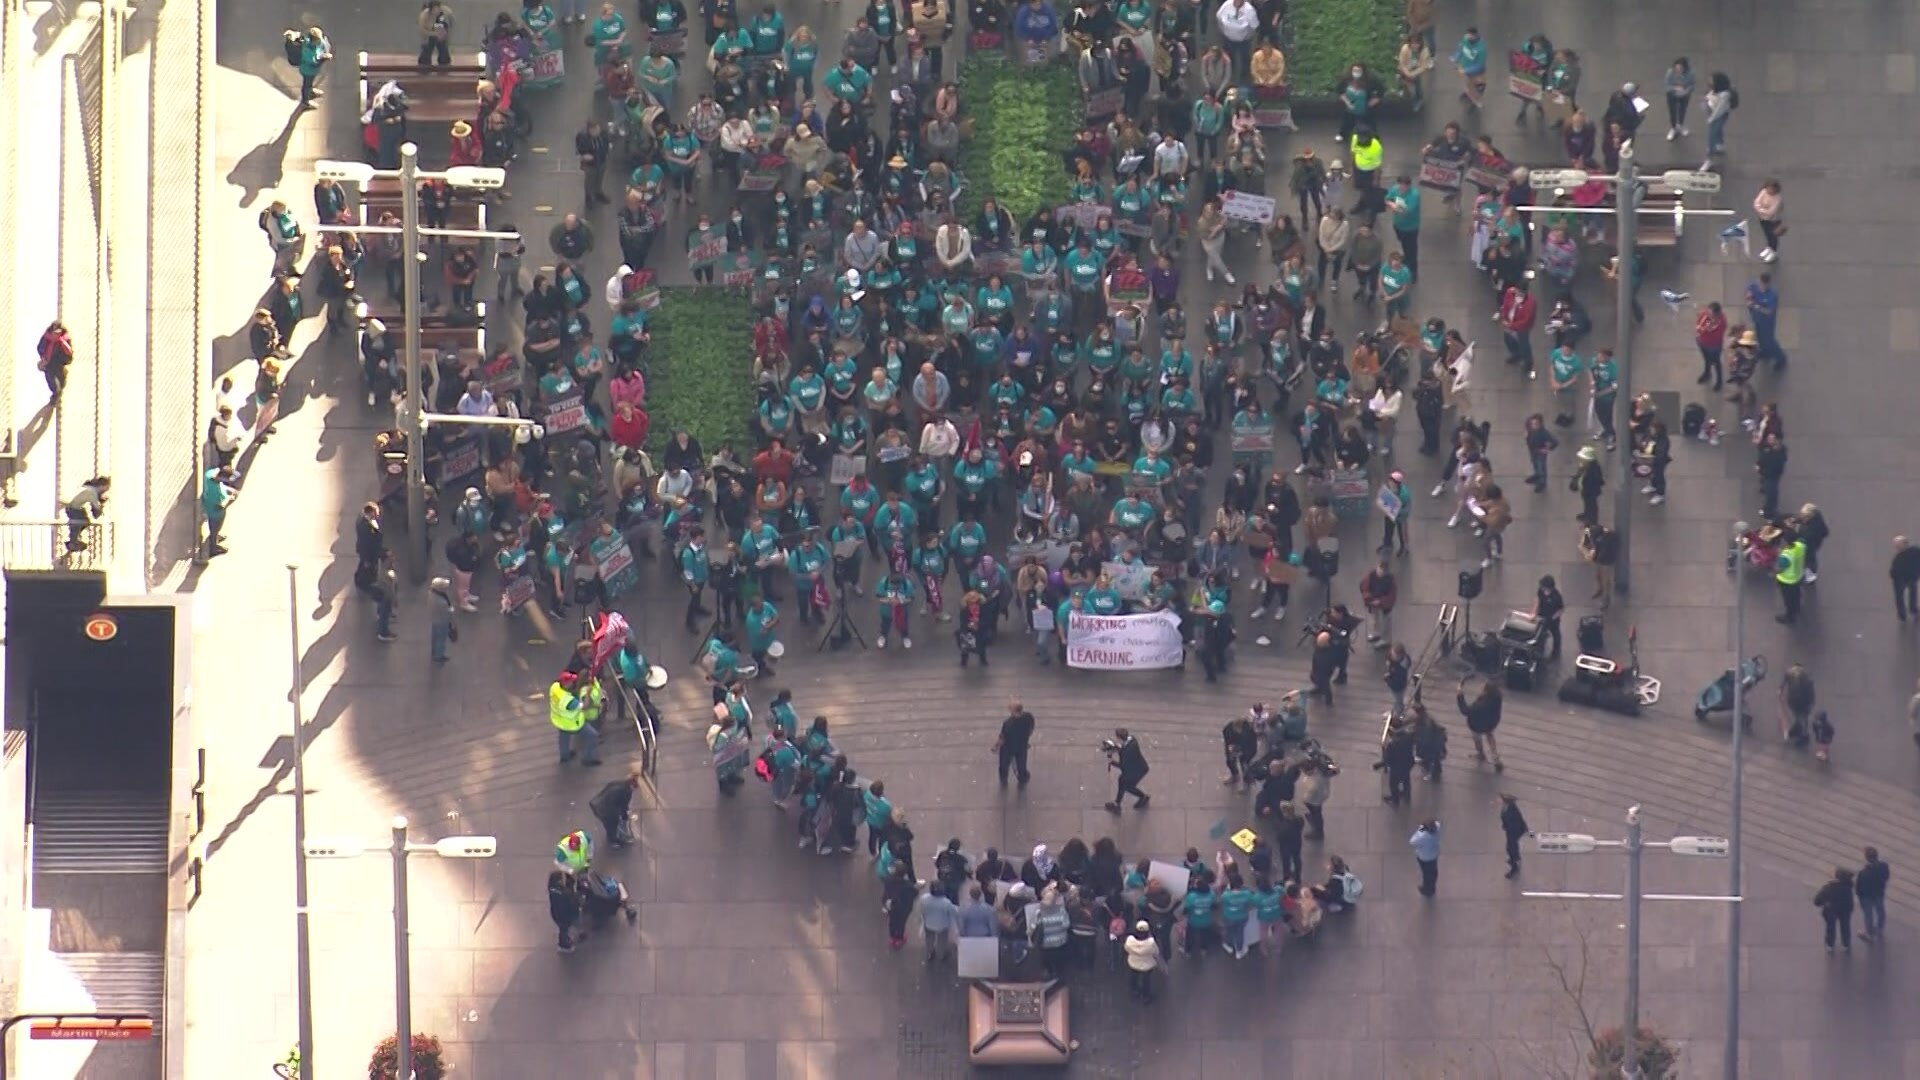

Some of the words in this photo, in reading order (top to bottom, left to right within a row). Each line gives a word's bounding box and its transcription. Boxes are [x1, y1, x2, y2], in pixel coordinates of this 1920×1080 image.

[1072, 617, 1127, 631] WORKING
[1070, 648, 1134, 666] LEARNING
[51, 1029, 93, 1038] Martin
[96, 1029, 131, 1038] Place
